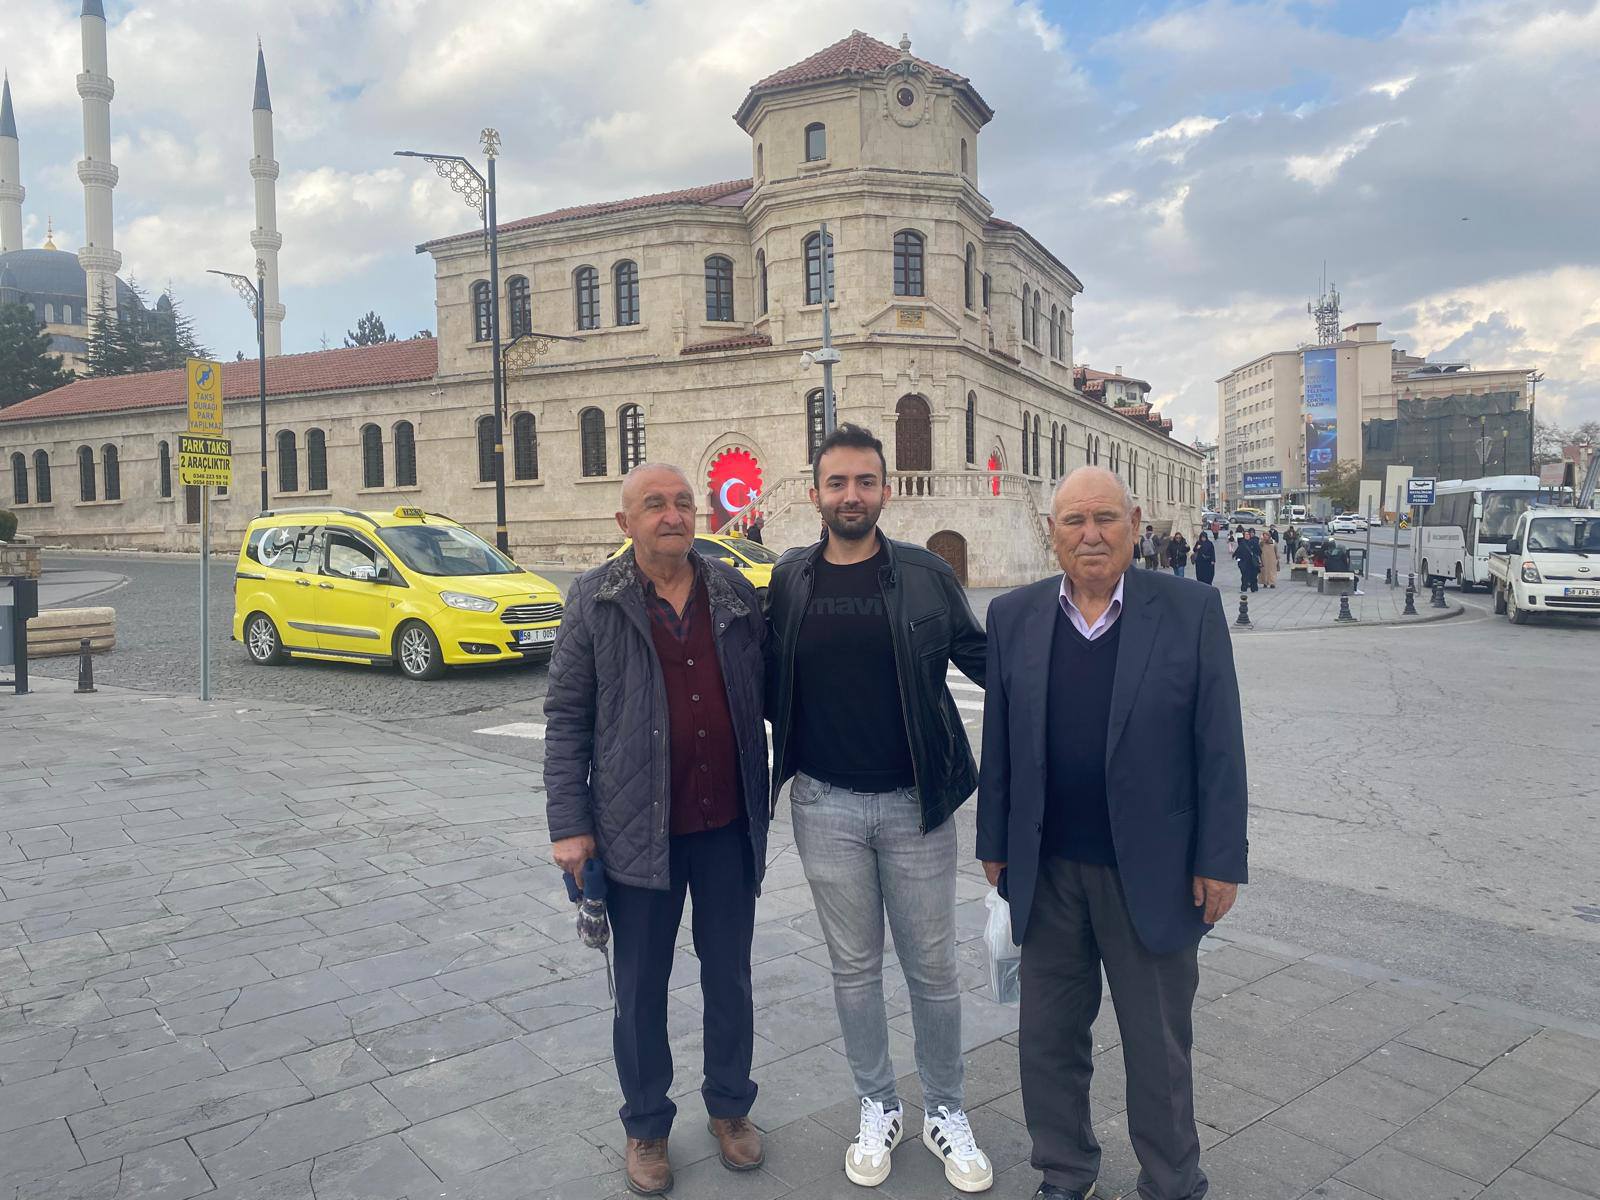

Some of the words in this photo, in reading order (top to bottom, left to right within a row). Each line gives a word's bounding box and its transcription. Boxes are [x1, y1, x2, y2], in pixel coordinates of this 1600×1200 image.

[196, 392, 215, 400] TAKSİ
[197, 412, 214, 420] PARK
[182, 438, 204, 452] PARK
[206, 440, 229, 454] TAKSİ
[180, 456, 186, 468] 2
[188, 456, 230, 472] ARAÇLIKTIR
[807, 593, 882, 616] mavi
[536, 630, 538, 640] T
